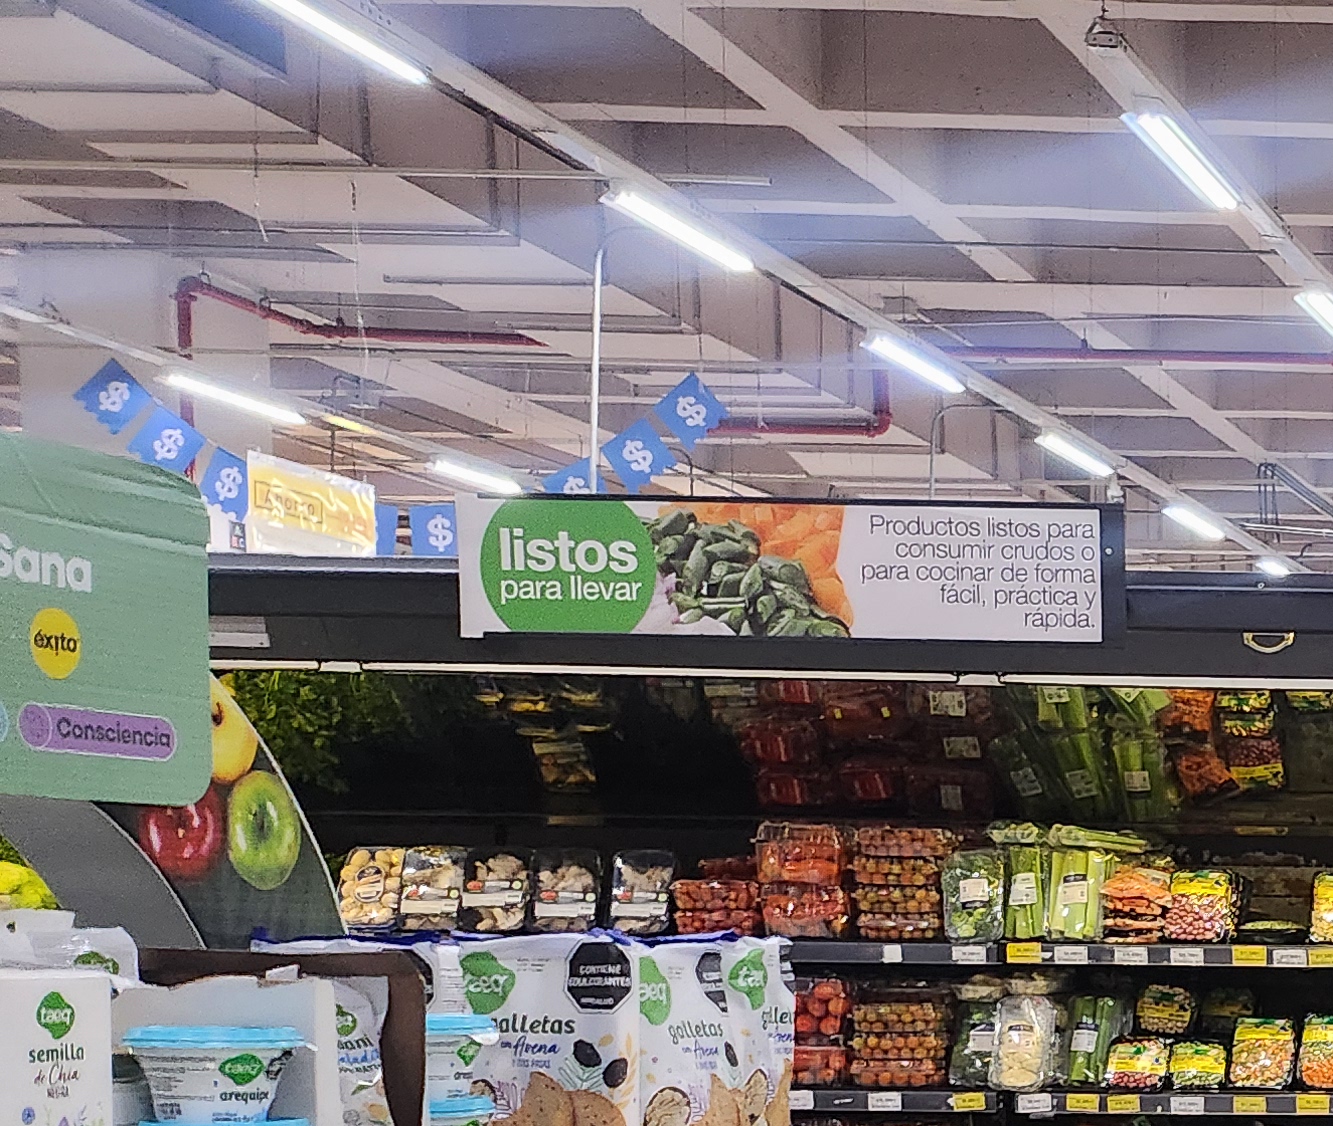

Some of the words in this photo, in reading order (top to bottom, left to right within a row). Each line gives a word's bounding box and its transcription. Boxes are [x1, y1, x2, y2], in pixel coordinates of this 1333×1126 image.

[869, 515, 981, 539] Productos
[987, 516, 1041, 539] listos
[1047, 523, 1095, 544] para
[500, 527, 638, 573] listos
[895, 540, 995, 562] consumir
[1001, 540, 1074, 563] crudos
[1080, 547, 1095, 562] o
[860, 564, 912, 584] para
[918, 563, 994, 583] cocinar
[1001, 562, 1028, 584] de
[1034, 562, 1096, 584] forma
[500, 579, 564, 605] para
[570, 575, 643, 602] llevar
[940, 583, 987, 608] fácil,
[993, 585, 1078, 612] práctica
[1082, 591, 1097, 611] y
[1024, 607, 1096, 633] rápida.
[34, 630, 79, 657] éxito
[55, 715, 172, 750] Consciencia
[466, 974, 509, 995] aeq
[28, 1043, 85, 1064] semilla
